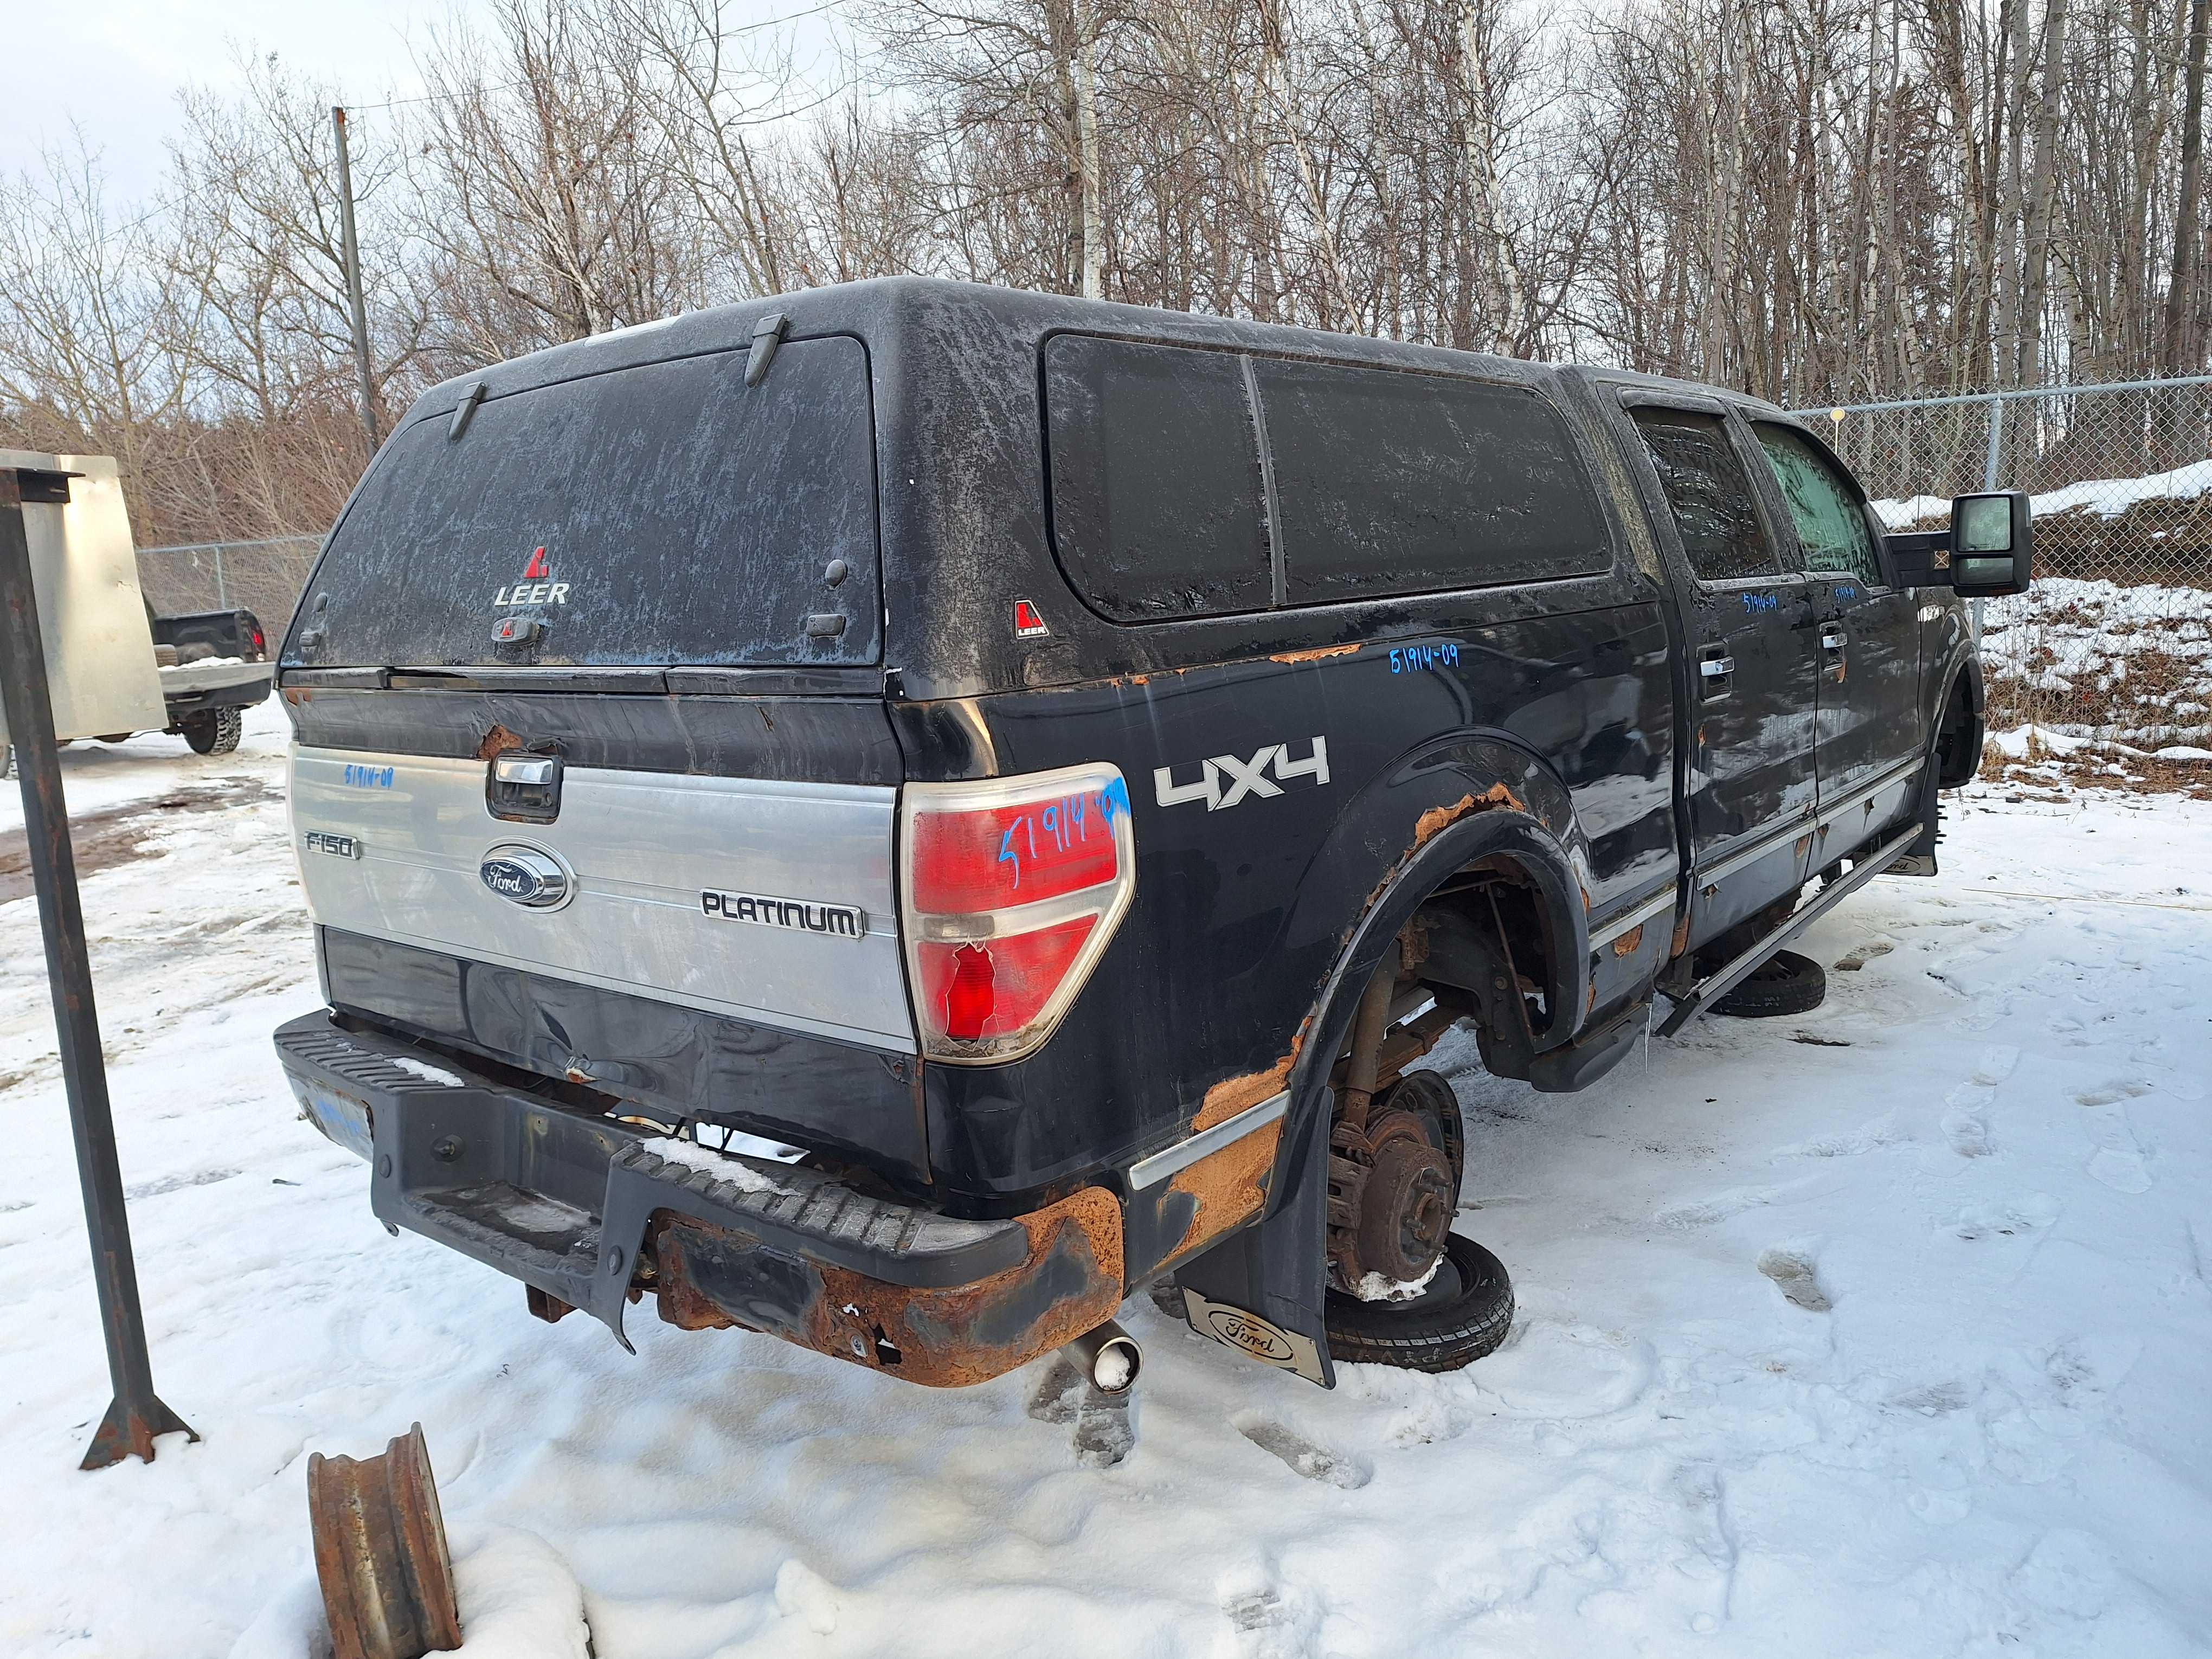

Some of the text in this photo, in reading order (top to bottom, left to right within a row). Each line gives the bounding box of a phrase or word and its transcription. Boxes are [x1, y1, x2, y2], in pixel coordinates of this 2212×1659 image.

[494, 583, 570, 606] LEER
[1743, 593, 1777, 613] 51914-09
[1018, 627, 1046, 636] LEER
[1389, 644, 1459, 673] 51914-09
[306, 832, 352, 857] F-150
[1887, 859, 1908, 870] ord
[487, 864, 524, 892] Ford
[702, 892, 856, 936] PLATINUM
[1225, 1318, 1275, 1353] Ford
